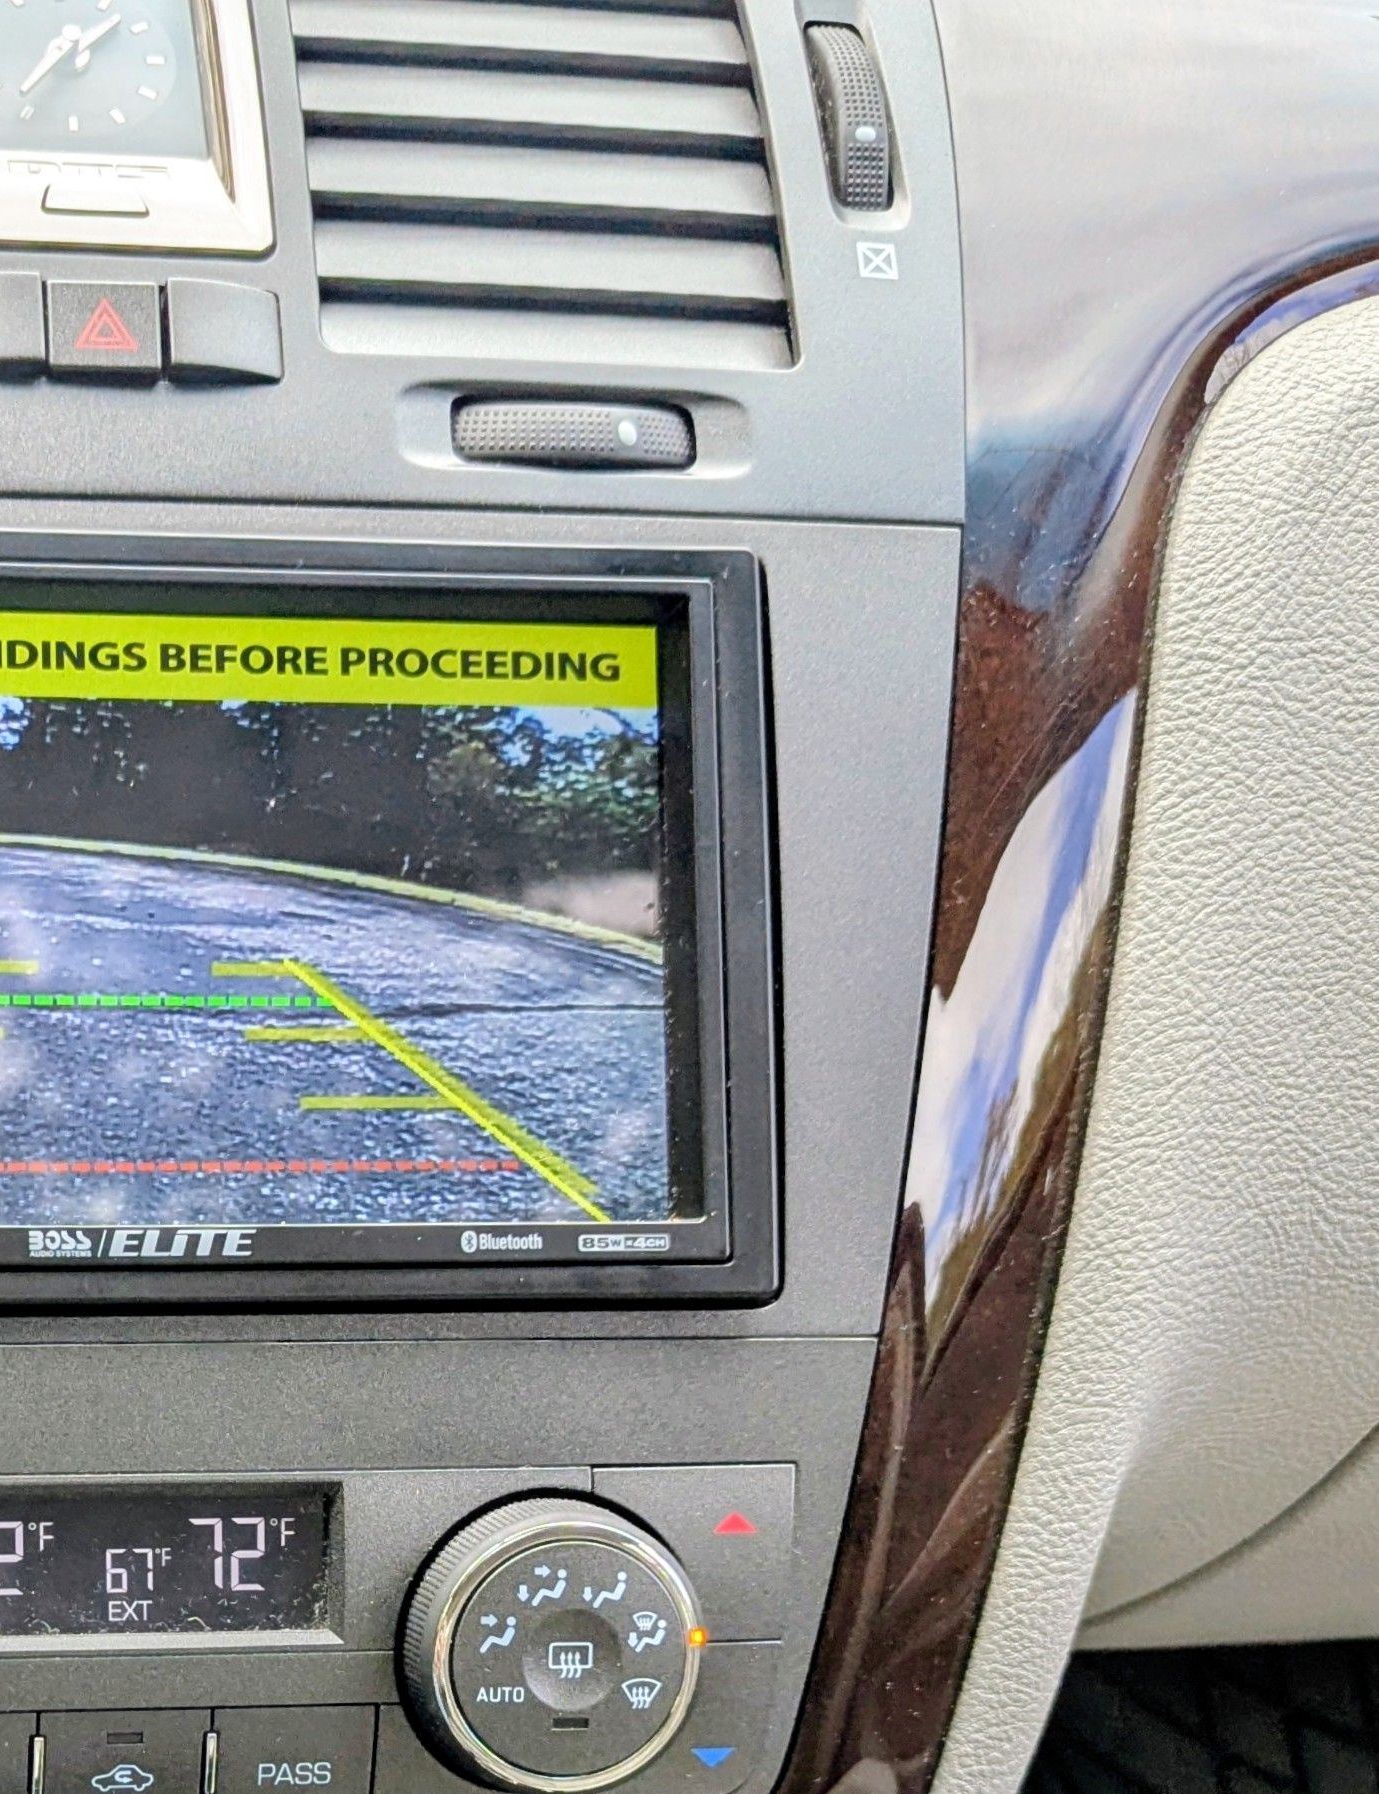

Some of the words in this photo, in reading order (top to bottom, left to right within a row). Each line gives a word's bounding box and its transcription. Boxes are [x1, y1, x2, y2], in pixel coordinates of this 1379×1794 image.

[159, 642, 329, 676] BEFORE
[340, 645, 621, 682] PROCEEDING
[27, 1229, 92, 1250] BOSS
[478, 1233, 543, 1250] Bluetooth
[29, 1250, 54, 1258] AUDIO
[55, 1250, 92, 1258] SYSTEMS
[108, 1600, 153, 1622] EXT
[475, 1686, 525, 1703] AUTO
[257, 1762, 331, 1786] PASS
